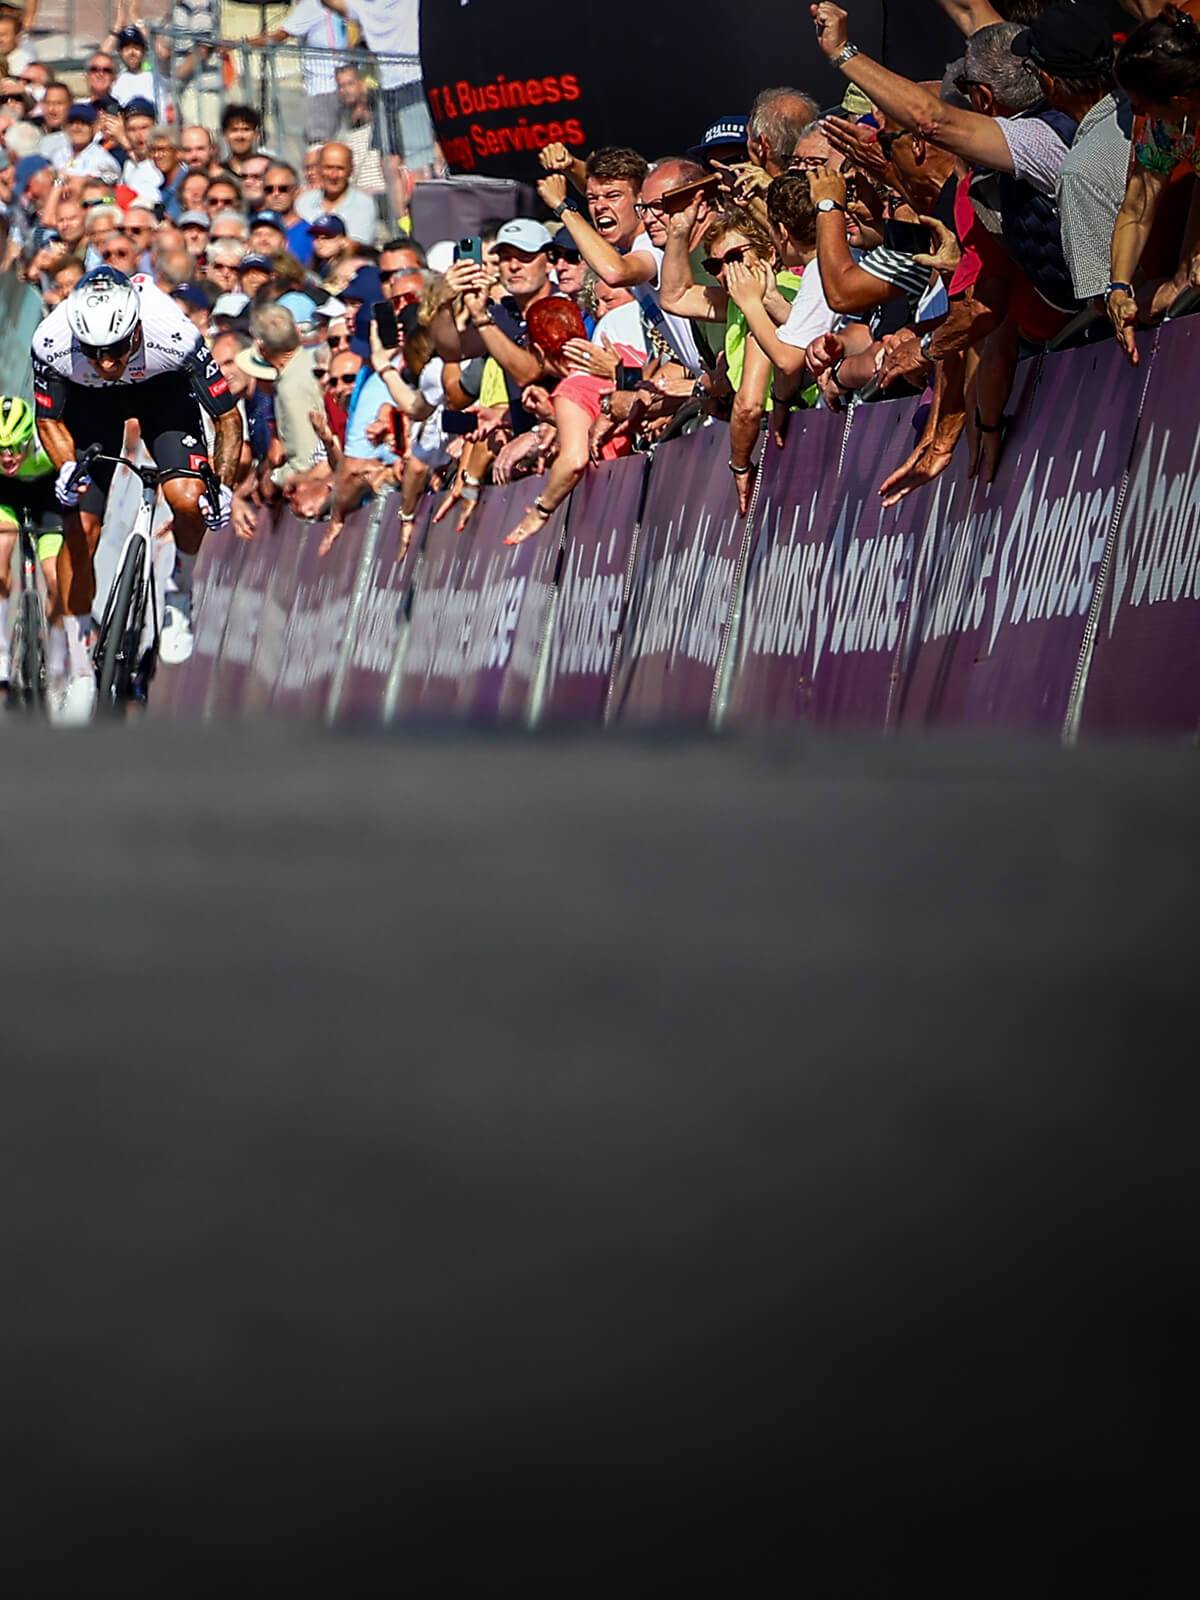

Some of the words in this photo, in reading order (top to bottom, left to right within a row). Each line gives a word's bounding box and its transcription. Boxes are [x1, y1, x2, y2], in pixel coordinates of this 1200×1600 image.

[456, 74, 580, 115] Business
[470, 118, 585, 156] Services
[830, 499, 915, 655] baloise
[924, 475, 1001, 643] baloise
[1010, 429, 1115, 624] baloise
[1131, 425, 1200, 607] balo
